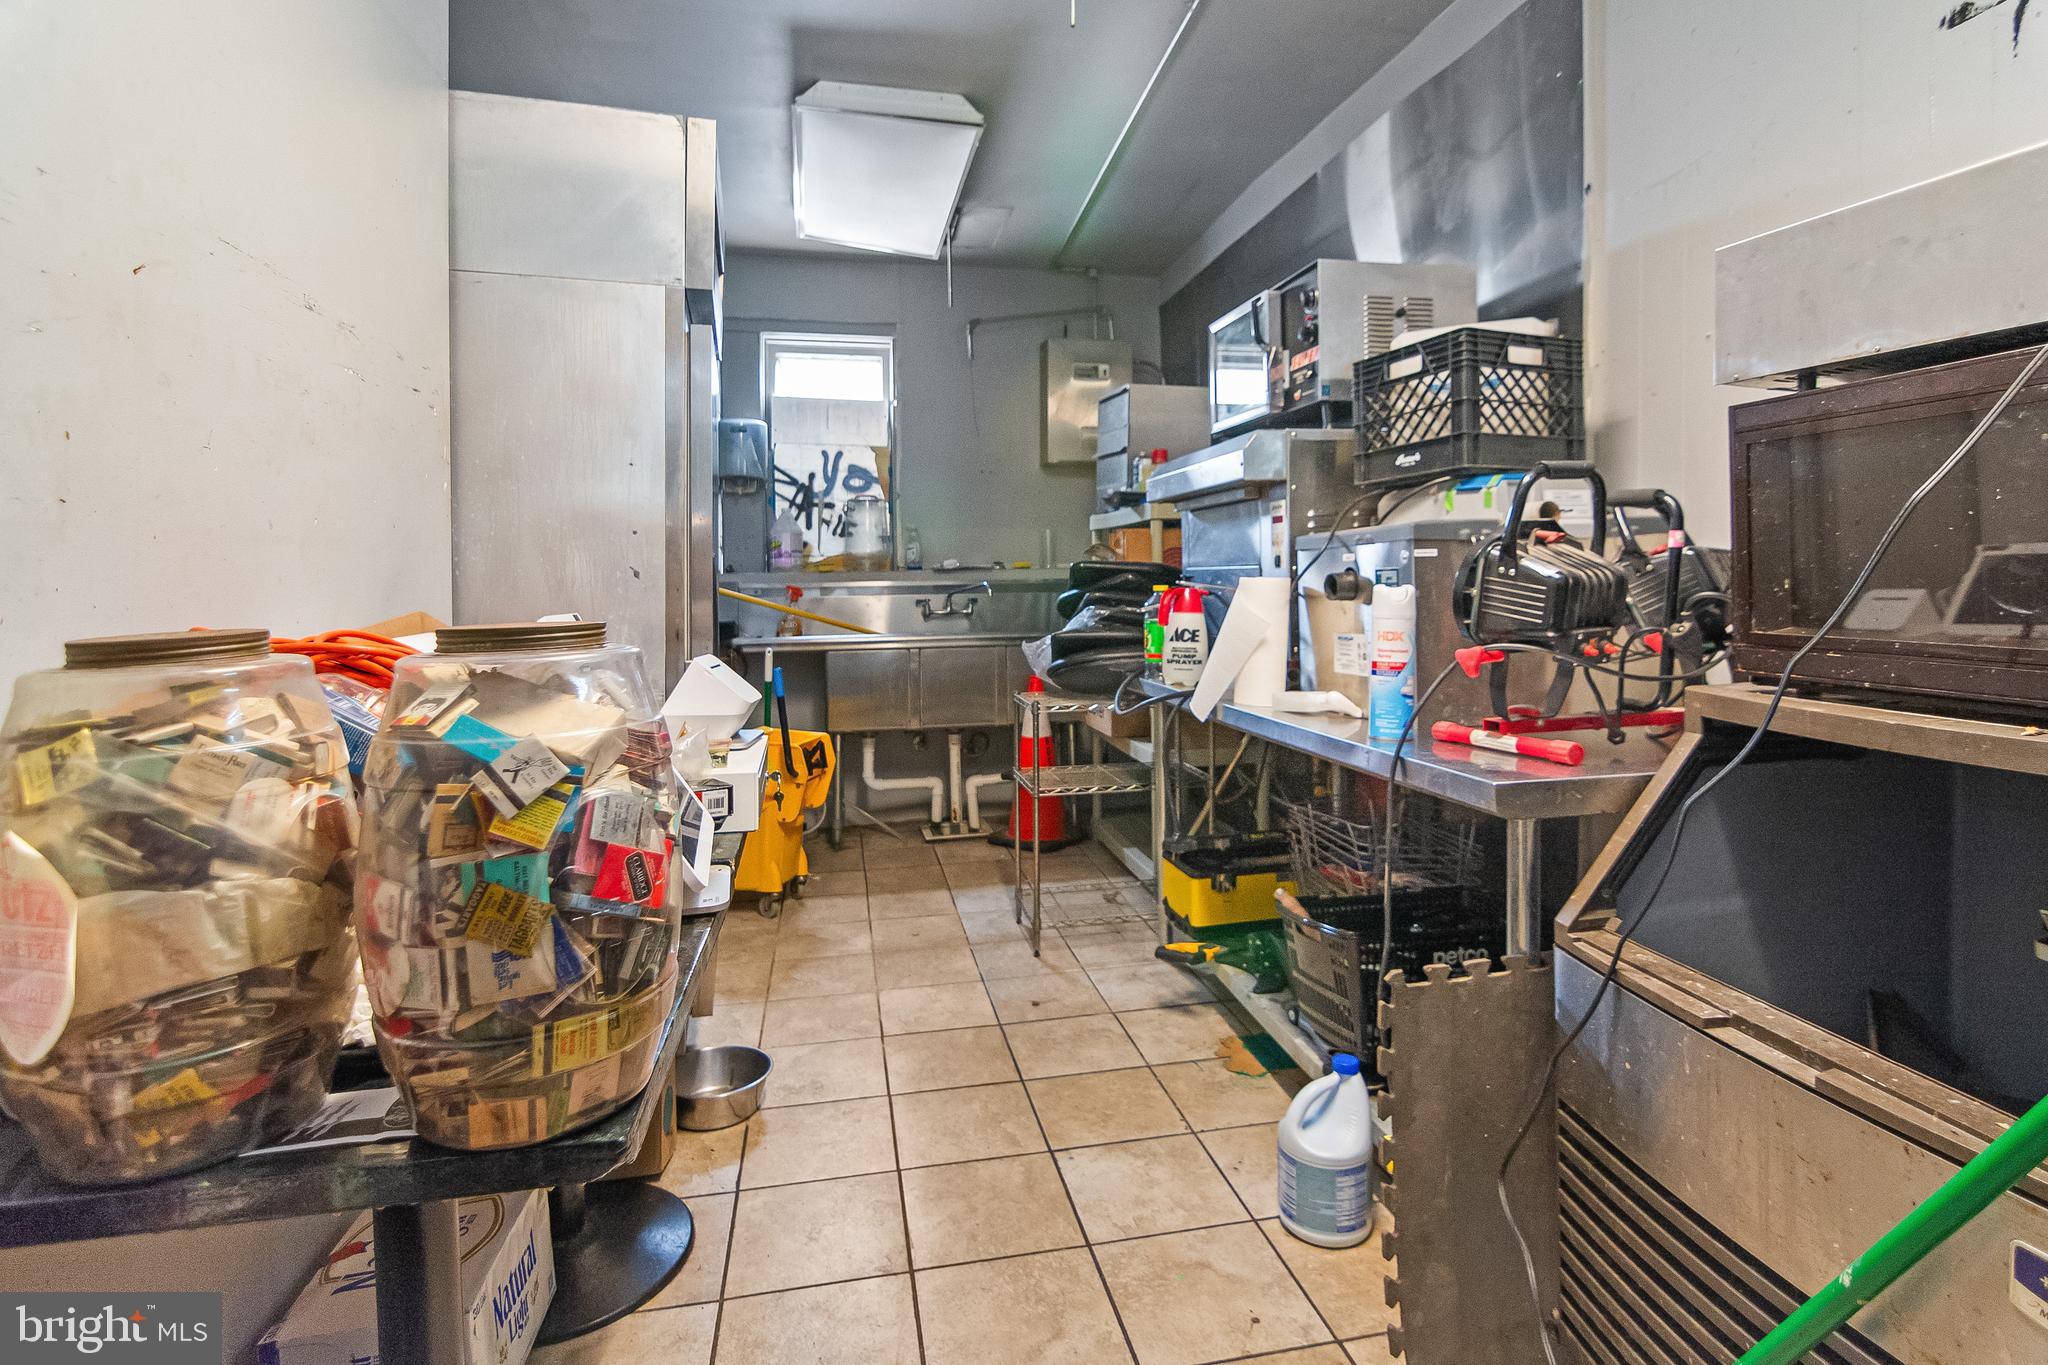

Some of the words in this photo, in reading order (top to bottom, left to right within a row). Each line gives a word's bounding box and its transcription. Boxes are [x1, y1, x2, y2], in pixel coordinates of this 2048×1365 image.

[1169, 627, 1200, 642] ACE
[1377, 631, 1403, 642] HDX
[632, 856, 648, 894] CLARIDGE
[493, 1227, 537, 1340] Natural
[508, 1290, 530, 1343] Light
